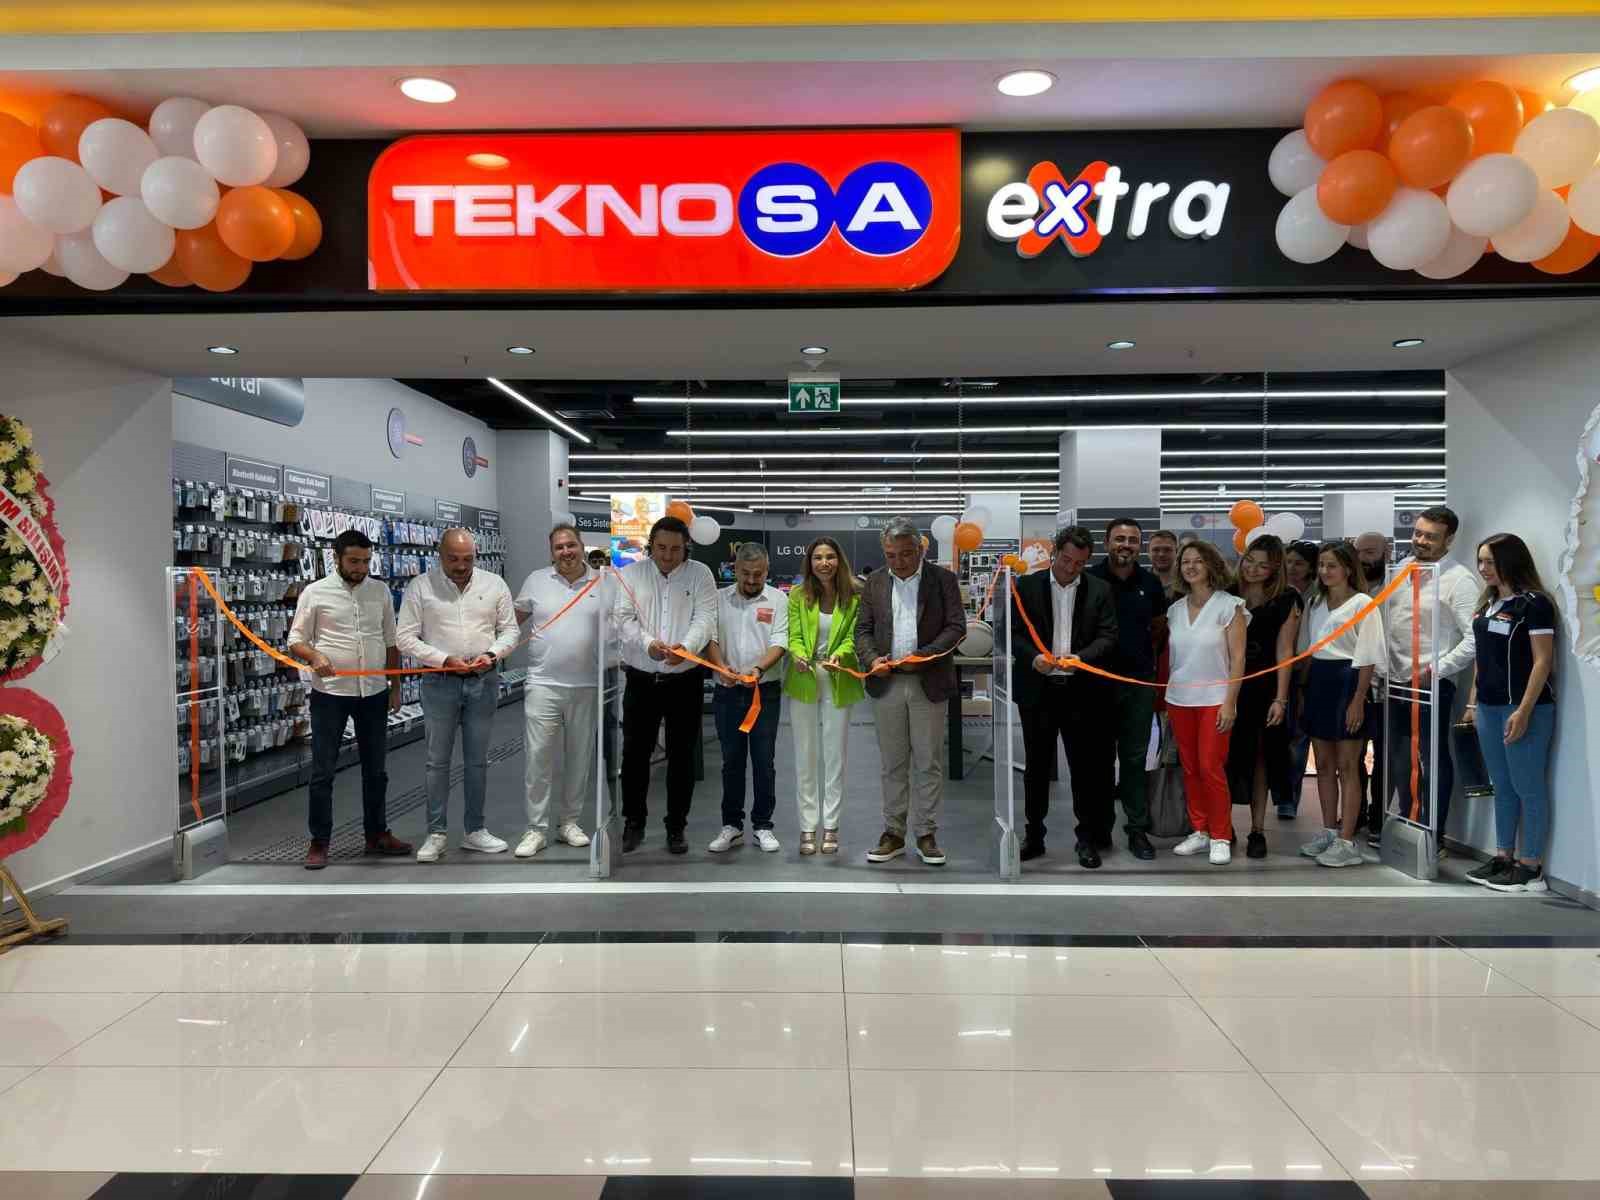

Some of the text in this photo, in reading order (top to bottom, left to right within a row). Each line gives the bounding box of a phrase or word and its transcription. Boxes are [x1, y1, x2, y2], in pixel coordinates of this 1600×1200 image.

[391, 182, 922, 238] TEKNOSA
[986, 163, 1231, 252] extra
[777, 545, 806, 556] LG OL
